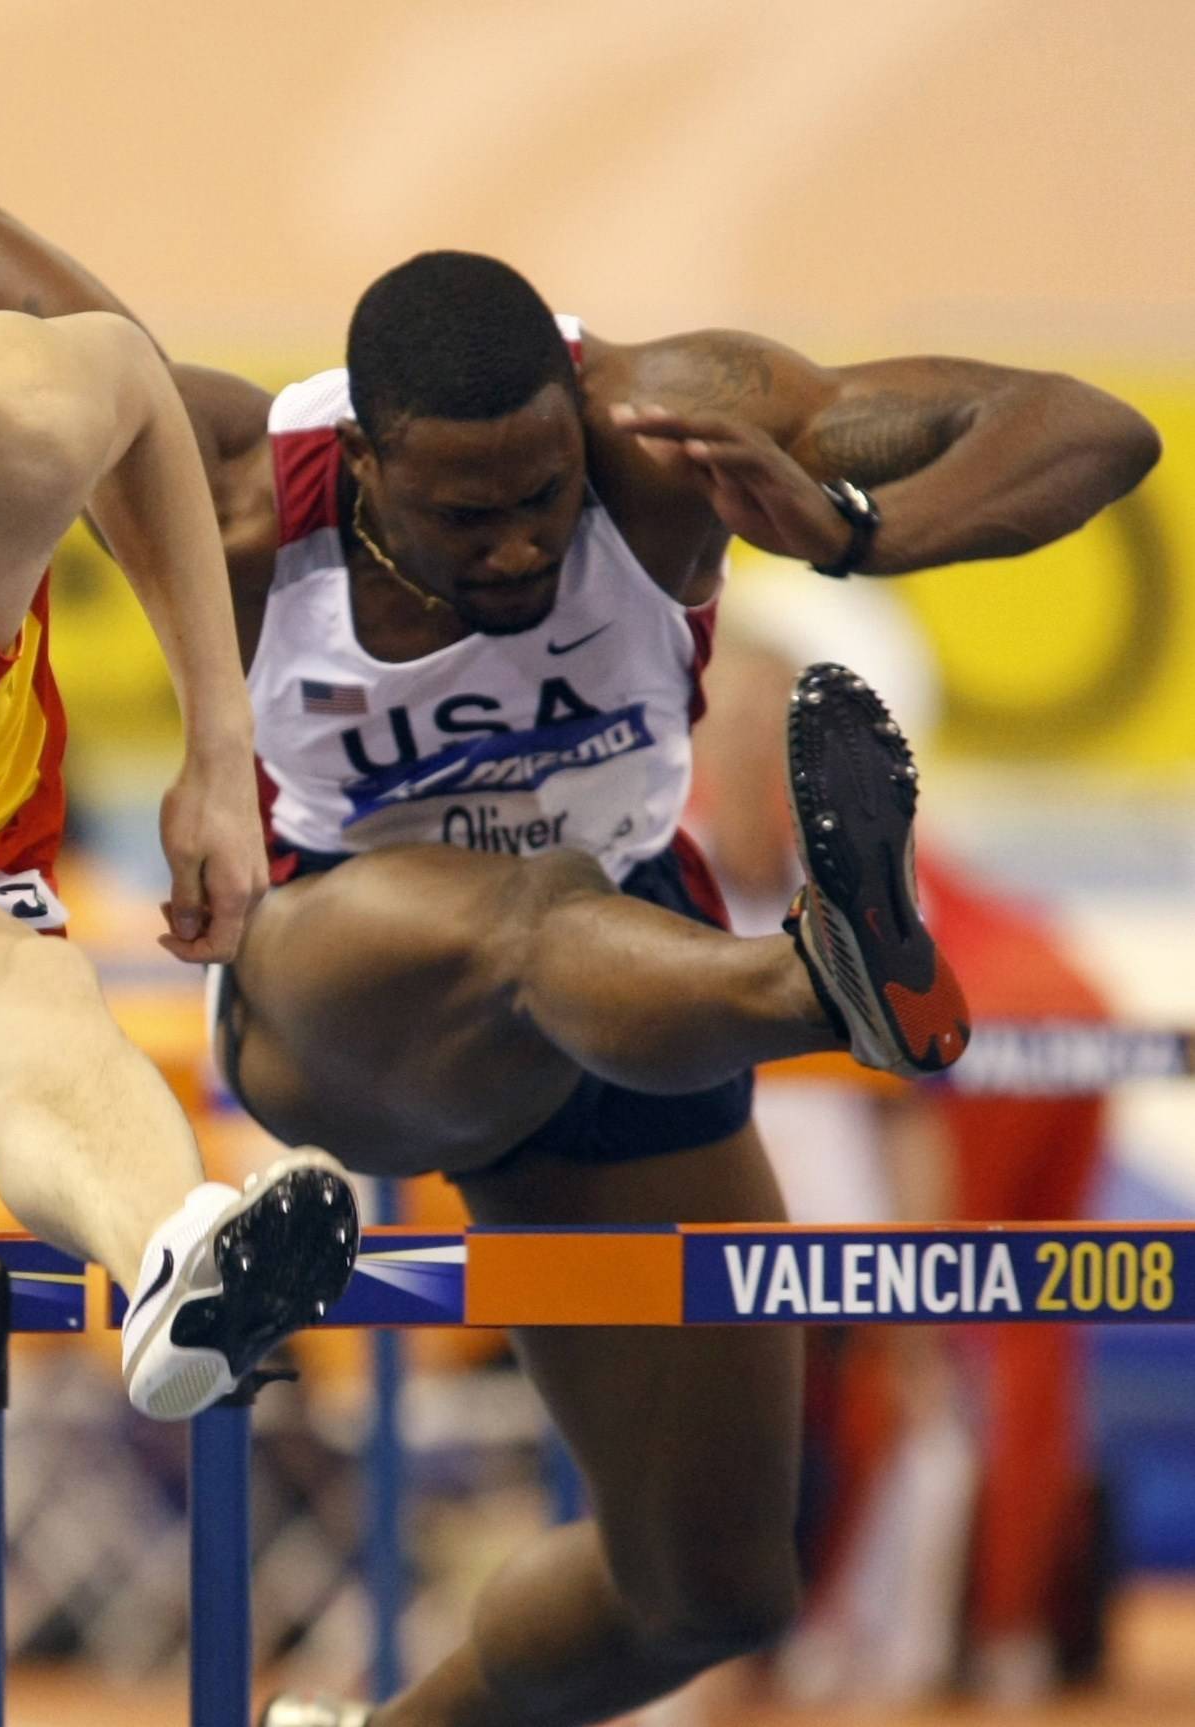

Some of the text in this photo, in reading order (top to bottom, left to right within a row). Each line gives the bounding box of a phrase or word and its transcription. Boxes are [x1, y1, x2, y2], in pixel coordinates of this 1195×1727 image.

[341, 676, 603, 776] USA
[442, 804, 568, 857] Oliver
[724, 1241, 1175, 1314] VALENCIA 2008
